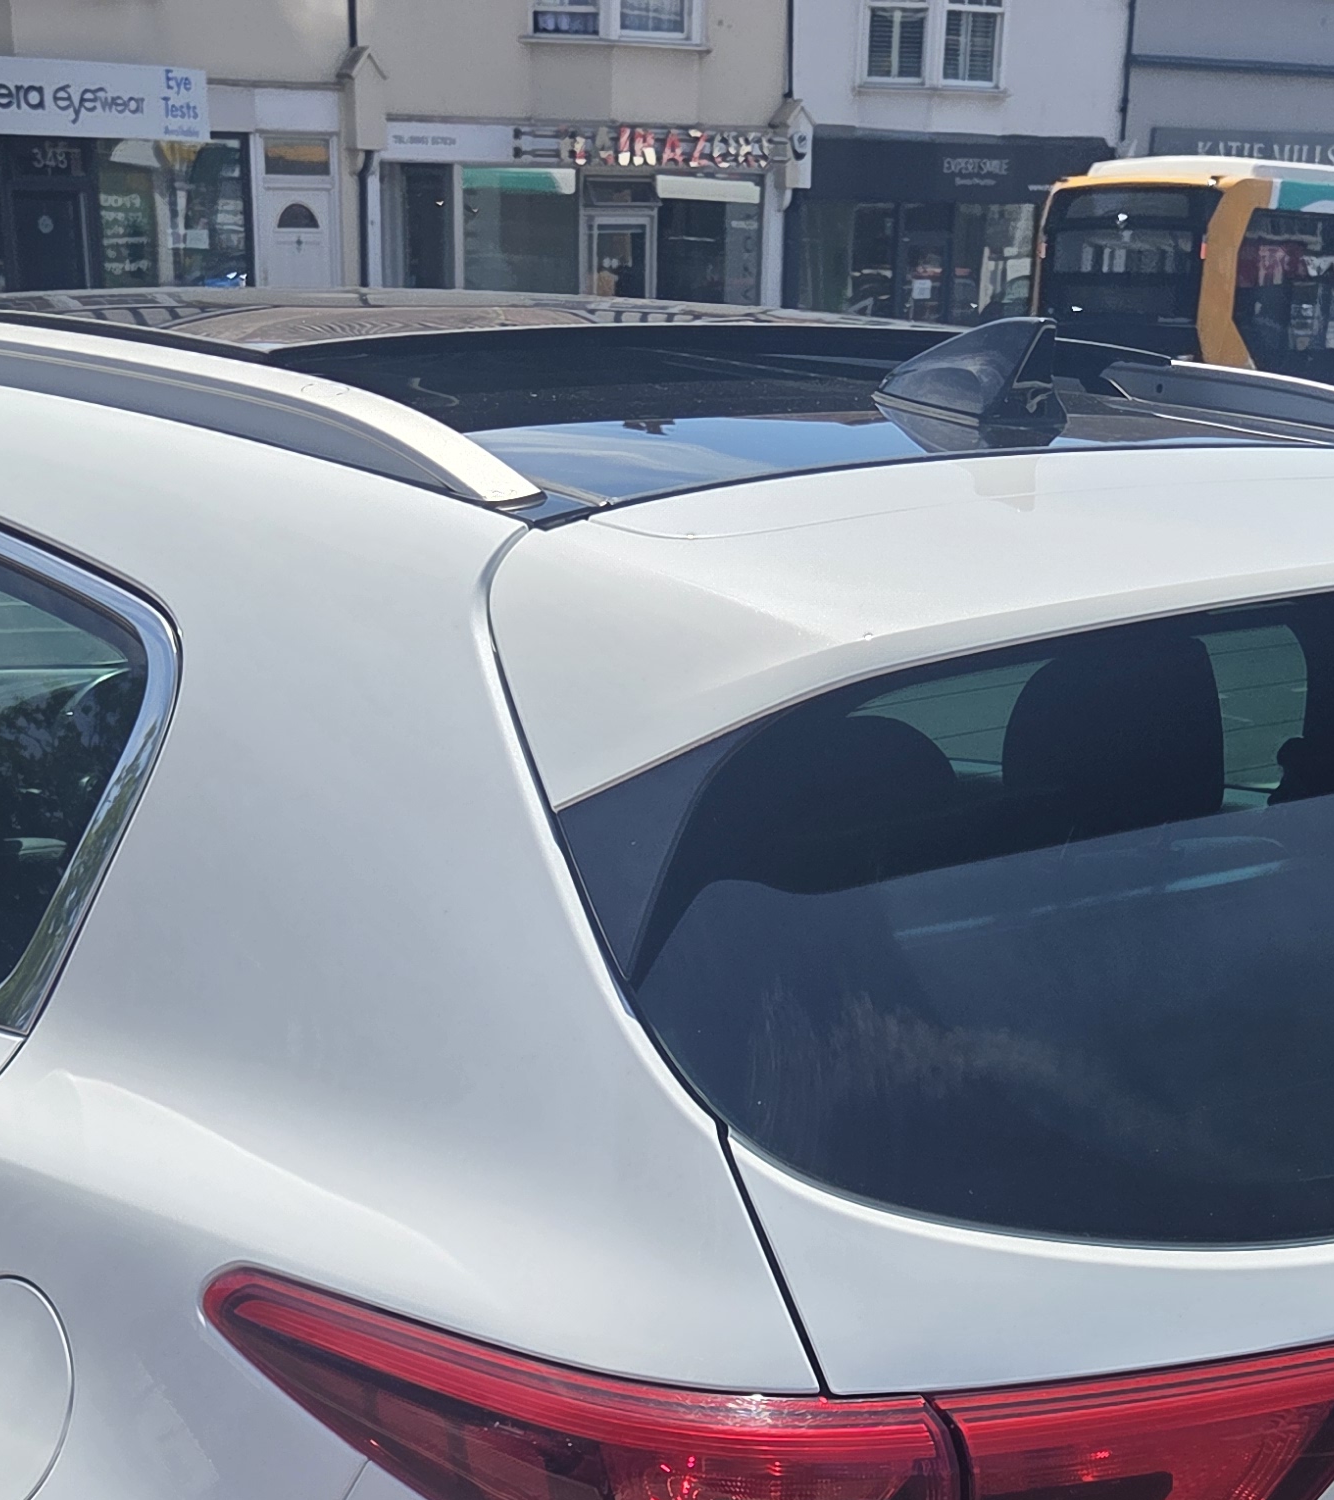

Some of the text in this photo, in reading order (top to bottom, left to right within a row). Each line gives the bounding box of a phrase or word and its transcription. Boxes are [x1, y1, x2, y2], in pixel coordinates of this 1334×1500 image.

[164, 69, 192, 95] Eye
[52, 84, 145, 125] eyewear
[161, 96, 199, 120] Tests
